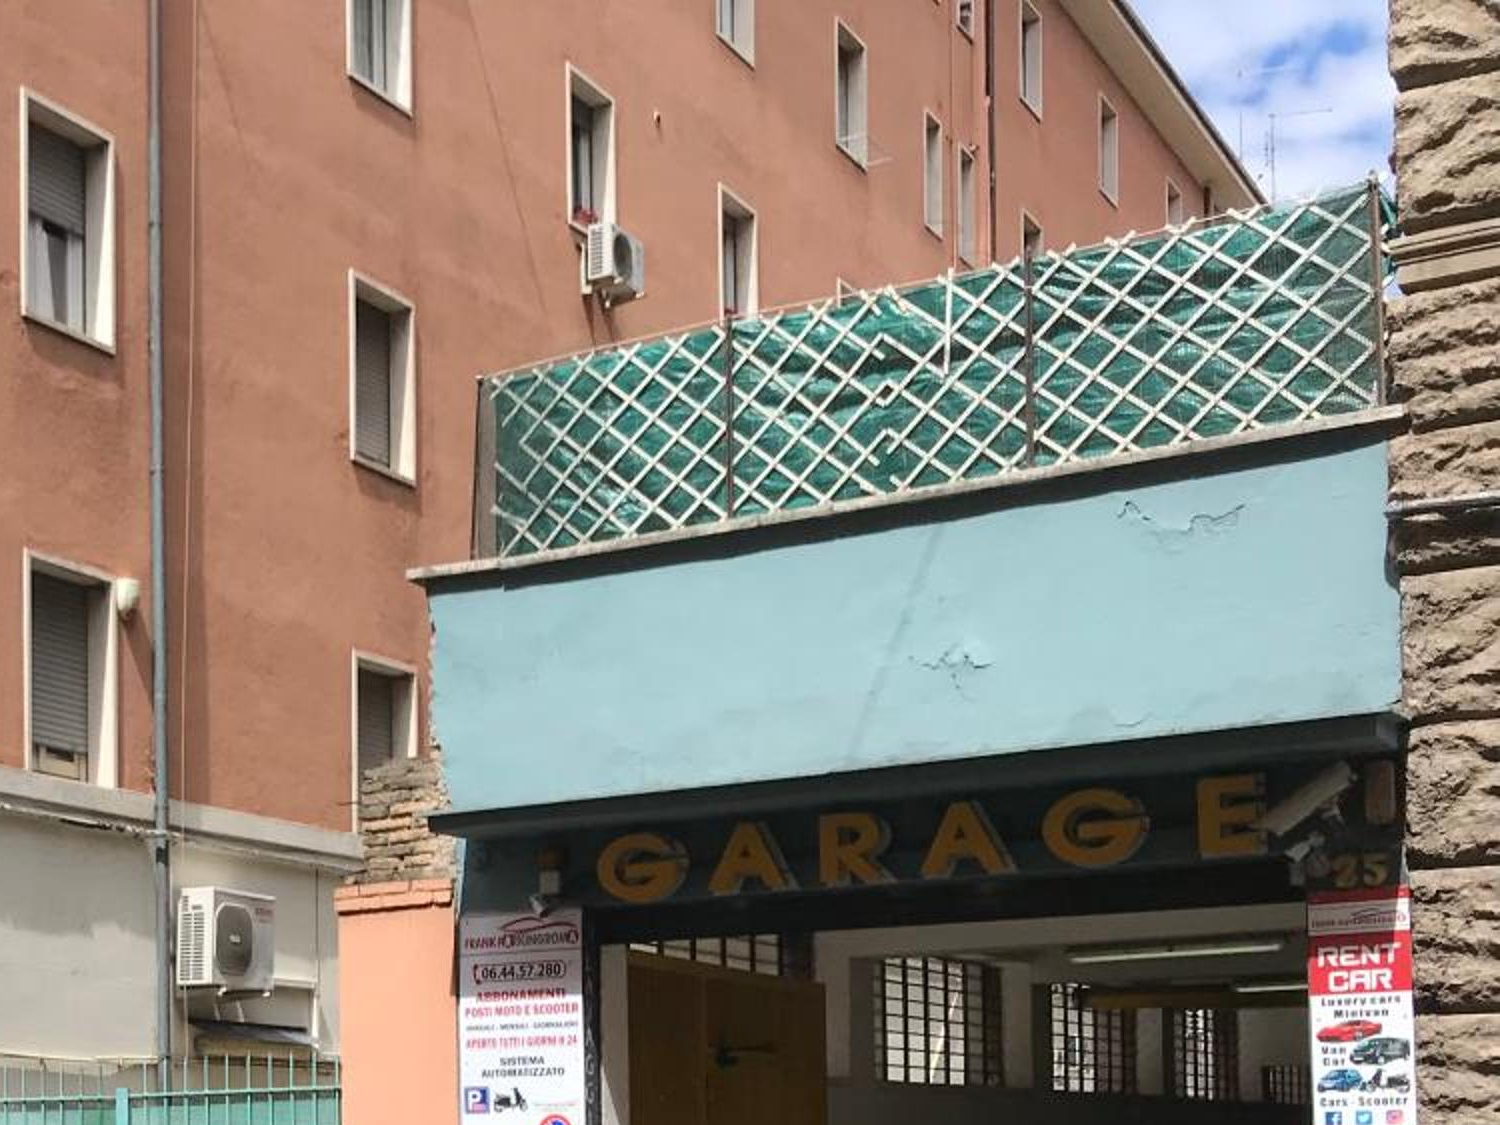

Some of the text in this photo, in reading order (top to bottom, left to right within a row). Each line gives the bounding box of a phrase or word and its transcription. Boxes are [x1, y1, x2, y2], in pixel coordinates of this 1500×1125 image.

[597, 773, 1266, 903] GARAGE
[1317, 942, 1401, 968] RENT
[481, 963, 562, 980] 06.44.57.280
[1328, 968, 1393, 993] CAR
[495, 1005, 522, 1017] MOTO
[534, 1003, 579, 1015] SCOOTER
[500, 1056, 545, 1066] SISTEMA
[481, 1067, 565, 1079] AUTOMATIZZATO
